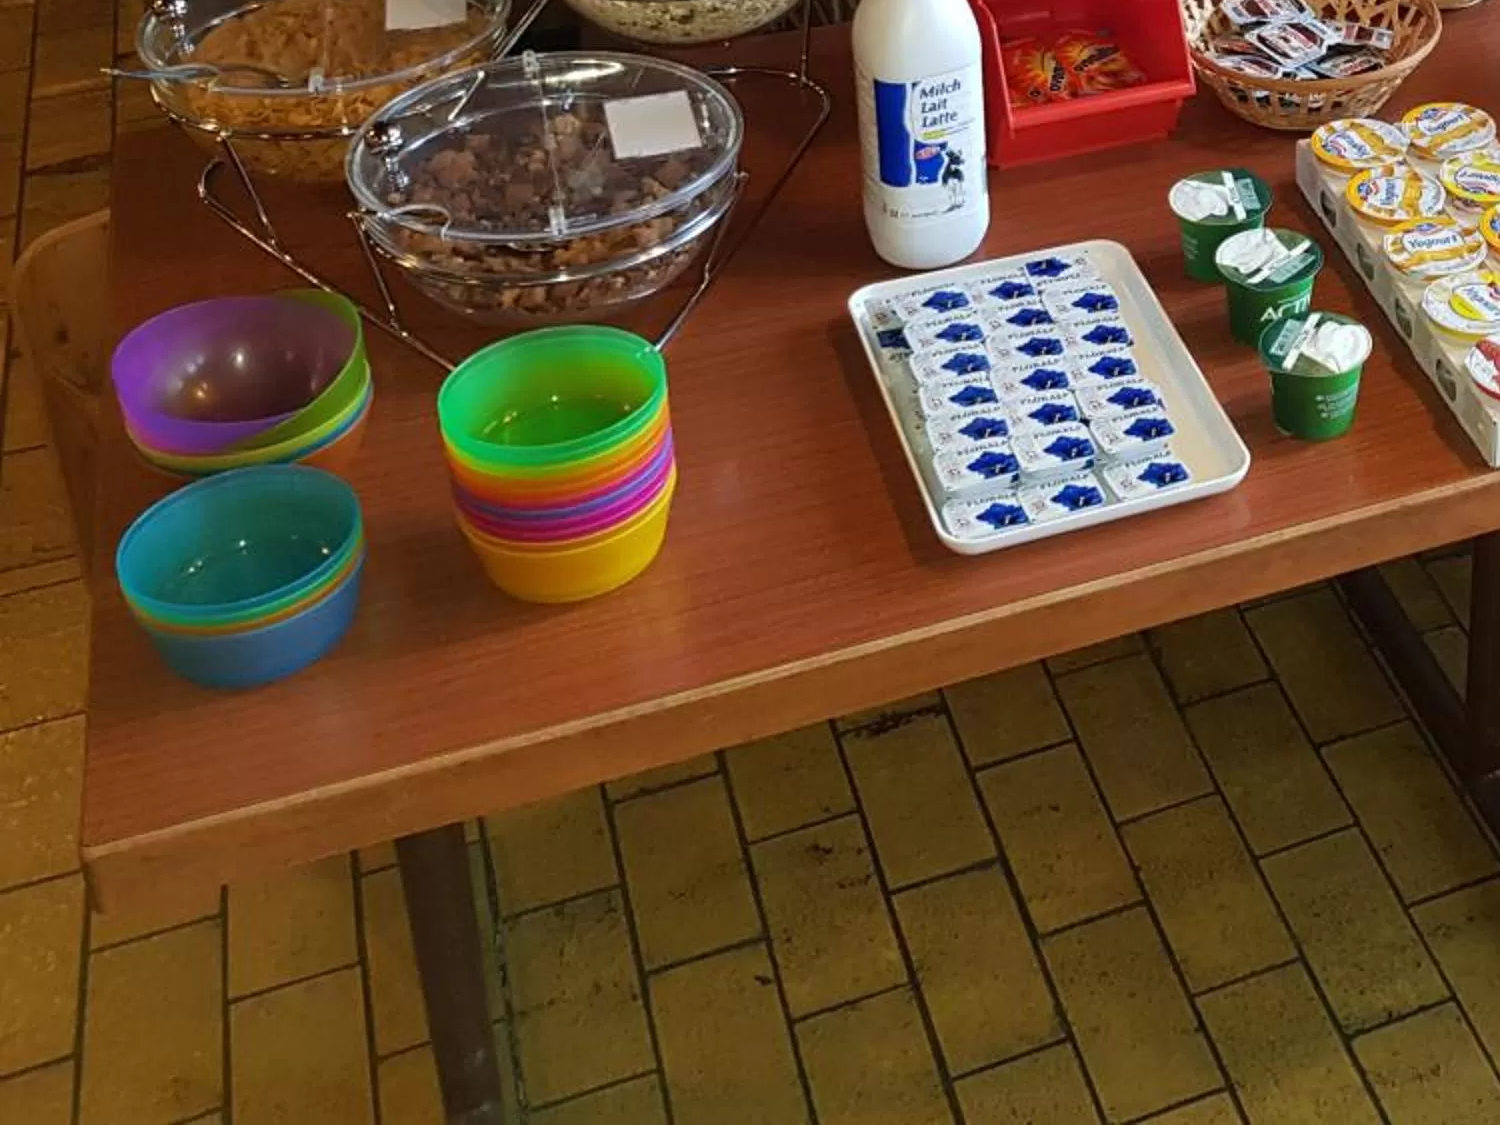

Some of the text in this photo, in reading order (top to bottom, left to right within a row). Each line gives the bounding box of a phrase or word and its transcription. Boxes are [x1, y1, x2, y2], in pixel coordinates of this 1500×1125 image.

[920, 78, 961, 99] Milch
[921, 98, 948, 114] Lait
[921, 111, 959, 128] Latte
